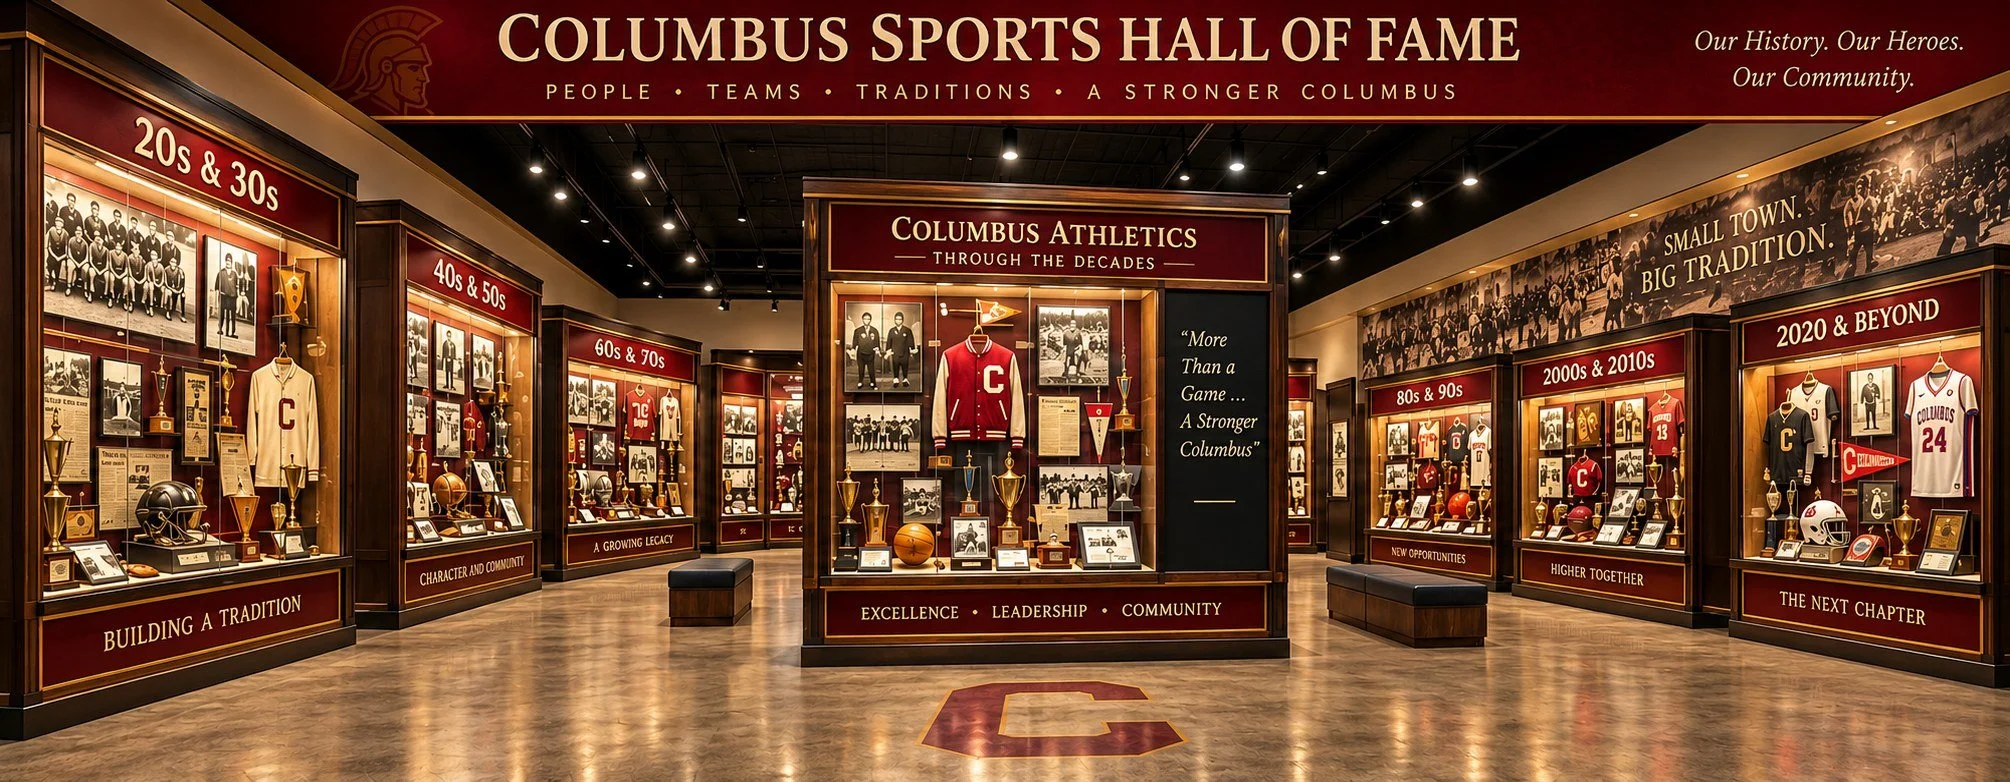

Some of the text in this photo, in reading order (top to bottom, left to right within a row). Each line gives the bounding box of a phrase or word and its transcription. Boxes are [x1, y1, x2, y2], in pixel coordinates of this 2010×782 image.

[498, 12, 1520, 62] COLUMBUS SPORTS HALL OF FAME
[1694, 29, 1964, 57] Our History. Our Heroes.
[546, 83, 1456, 100] PEOPLE TEAMS TRADITIONS A STRONGER COLUMBUS
[1732, 66, 1914, 93] Our Community.
[134, 116, 279, 211] 20s & 30s
[891, 216, 1197, 249] COLUMBUS ATHLETICS
[1664, 195, 1802, 256] SMALL TOWN.
[932, 251, 1155, 270] THROUGH THE DECADES
[1641, 222, 1834, 295] BIG TRADITION.
[433, 258, 506, 311] 40s & 50s
[1776, 298, 1940, 348] 2020 & BEYOND
[595, 338, 665, 369] 60s & 70s
[1182, 357, 1236, 375] Than a
[983, 364, 1005, 394] C
[1543, 350, 1655, 386] 2000s & 2010s
[1181, 385, 1226, 401] Game
[1396, 382, 1463, 406] 80s & 90s
[278, 397, 296, 430] C
[1180, 412, 1258, 434] A Stronger
[1656, 423, 1668, 441] 13
[1780, 427, 1793, 452] C
[1922, 426, 1947, 453] 24
[1843, 447, 1857, 475] C
[1576, 468, 1589, 488] C
[593, 541, 600, 553] A
[603, 537, 643, 552] GROWING
[1391, 546, 1408, 557] NEW
[420, 566, 468, 587] CHARACTER
[469, 561, 485, 577] AND
[1551, 563, 1644, 586] HIGHER TOGETHER
[861, 602, 1222, 621] EXCELLENCE LEADERSHIP COMMUNITY
[1779, 590, 1926, 626] THE NEXT CHAPTER
[103, 595, 301, 652] BUILDING A TRADITION
[915, 680, 1189, 758] C
